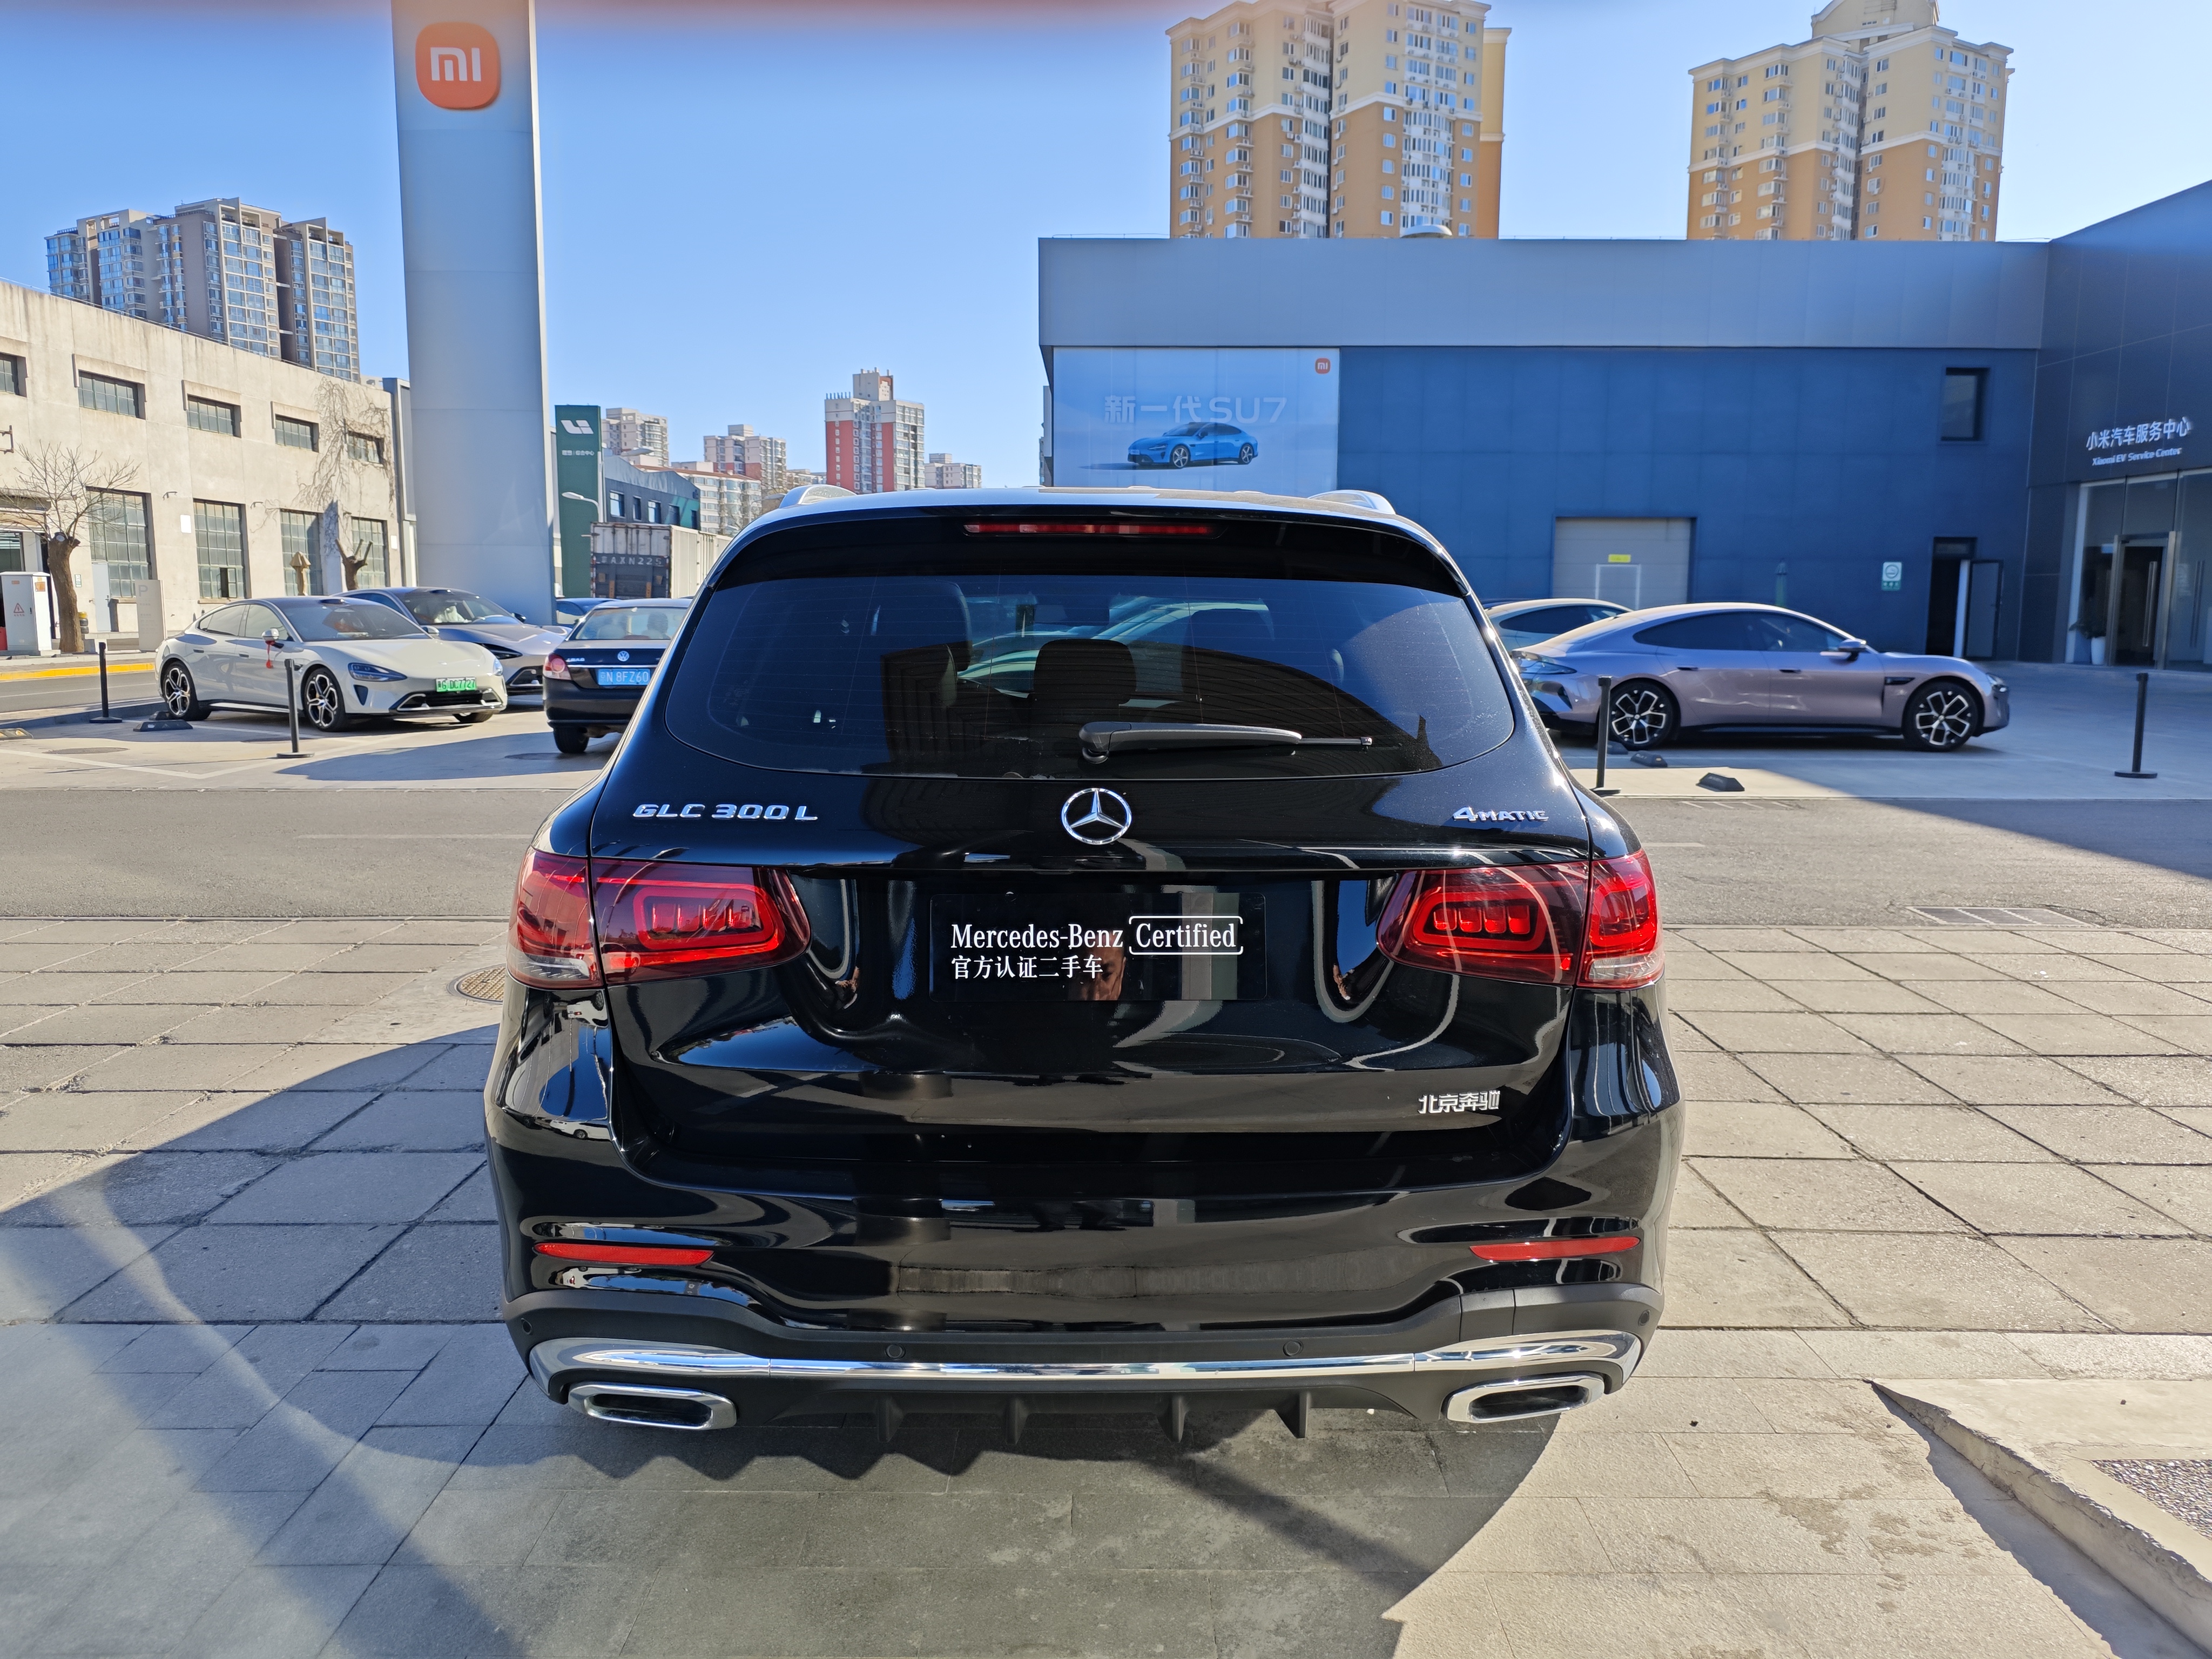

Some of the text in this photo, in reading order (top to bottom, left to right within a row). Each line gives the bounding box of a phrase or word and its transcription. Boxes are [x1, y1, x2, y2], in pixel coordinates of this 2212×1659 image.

[2086, 416, 2192, 450] 小米汽车服务中心
[2092, 447, 2182, 466] Xiaomi EV Service Center
[138, 584, 148, 597] P
[632, 804, 818, 821] GLC 300 L
[1453, 806, 1549, 821] 4MATIC
[951, 923, 1236, 949] Mercedes-Benz Certified
[952, 954, 1103, 979] 官方认证二手车
[1418, 1090, 1500, 1114] 北京奔驰
